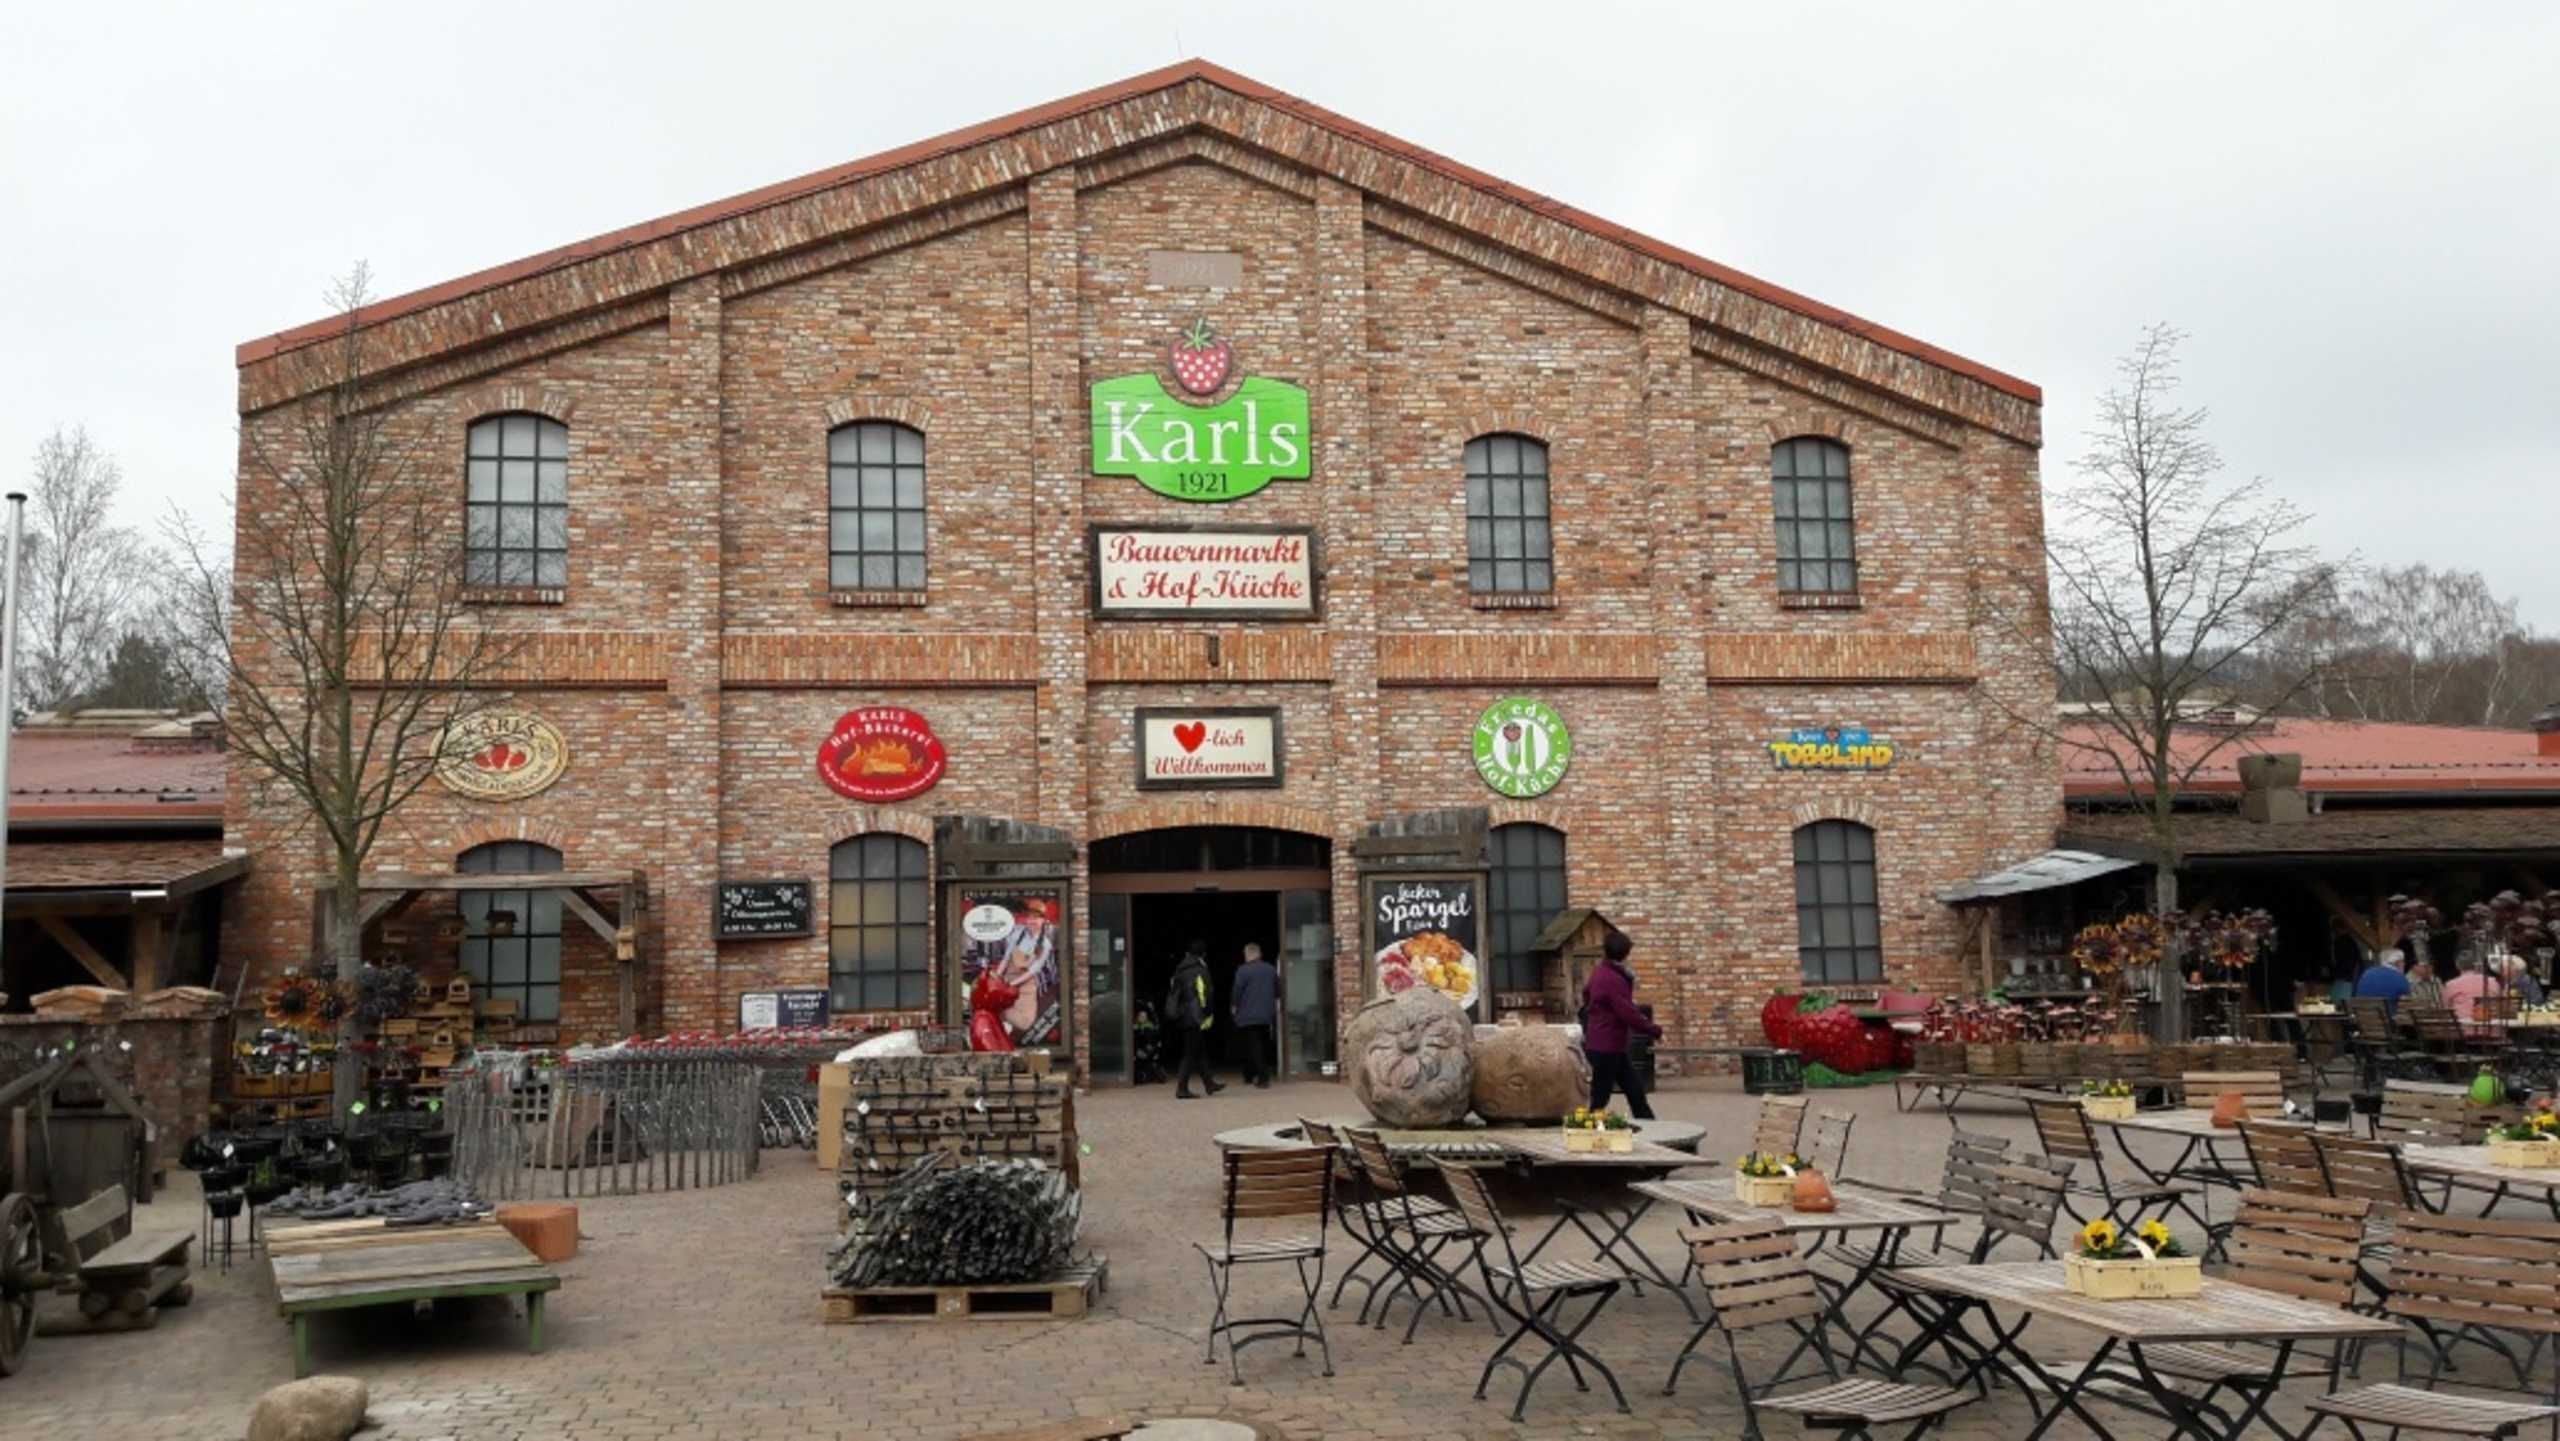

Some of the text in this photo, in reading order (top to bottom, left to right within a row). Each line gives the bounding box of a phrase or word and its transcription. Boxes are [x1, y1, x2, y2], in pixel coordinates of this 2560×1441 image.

[1103, 400, 1299, 467] Karls
[1176, 472, 1228, 494] 1921
[1107, 535, 1301, 564] Bauernmarkt
[1107, 569, 1304, 608] & Hof-Küche
[462, 718, 539, 739] KARLS
[858, 710, 906, 722] KARLS
[1153, 755, 1267, 775] Willkommen
[1378, 892, 1472, 936] Spargel
